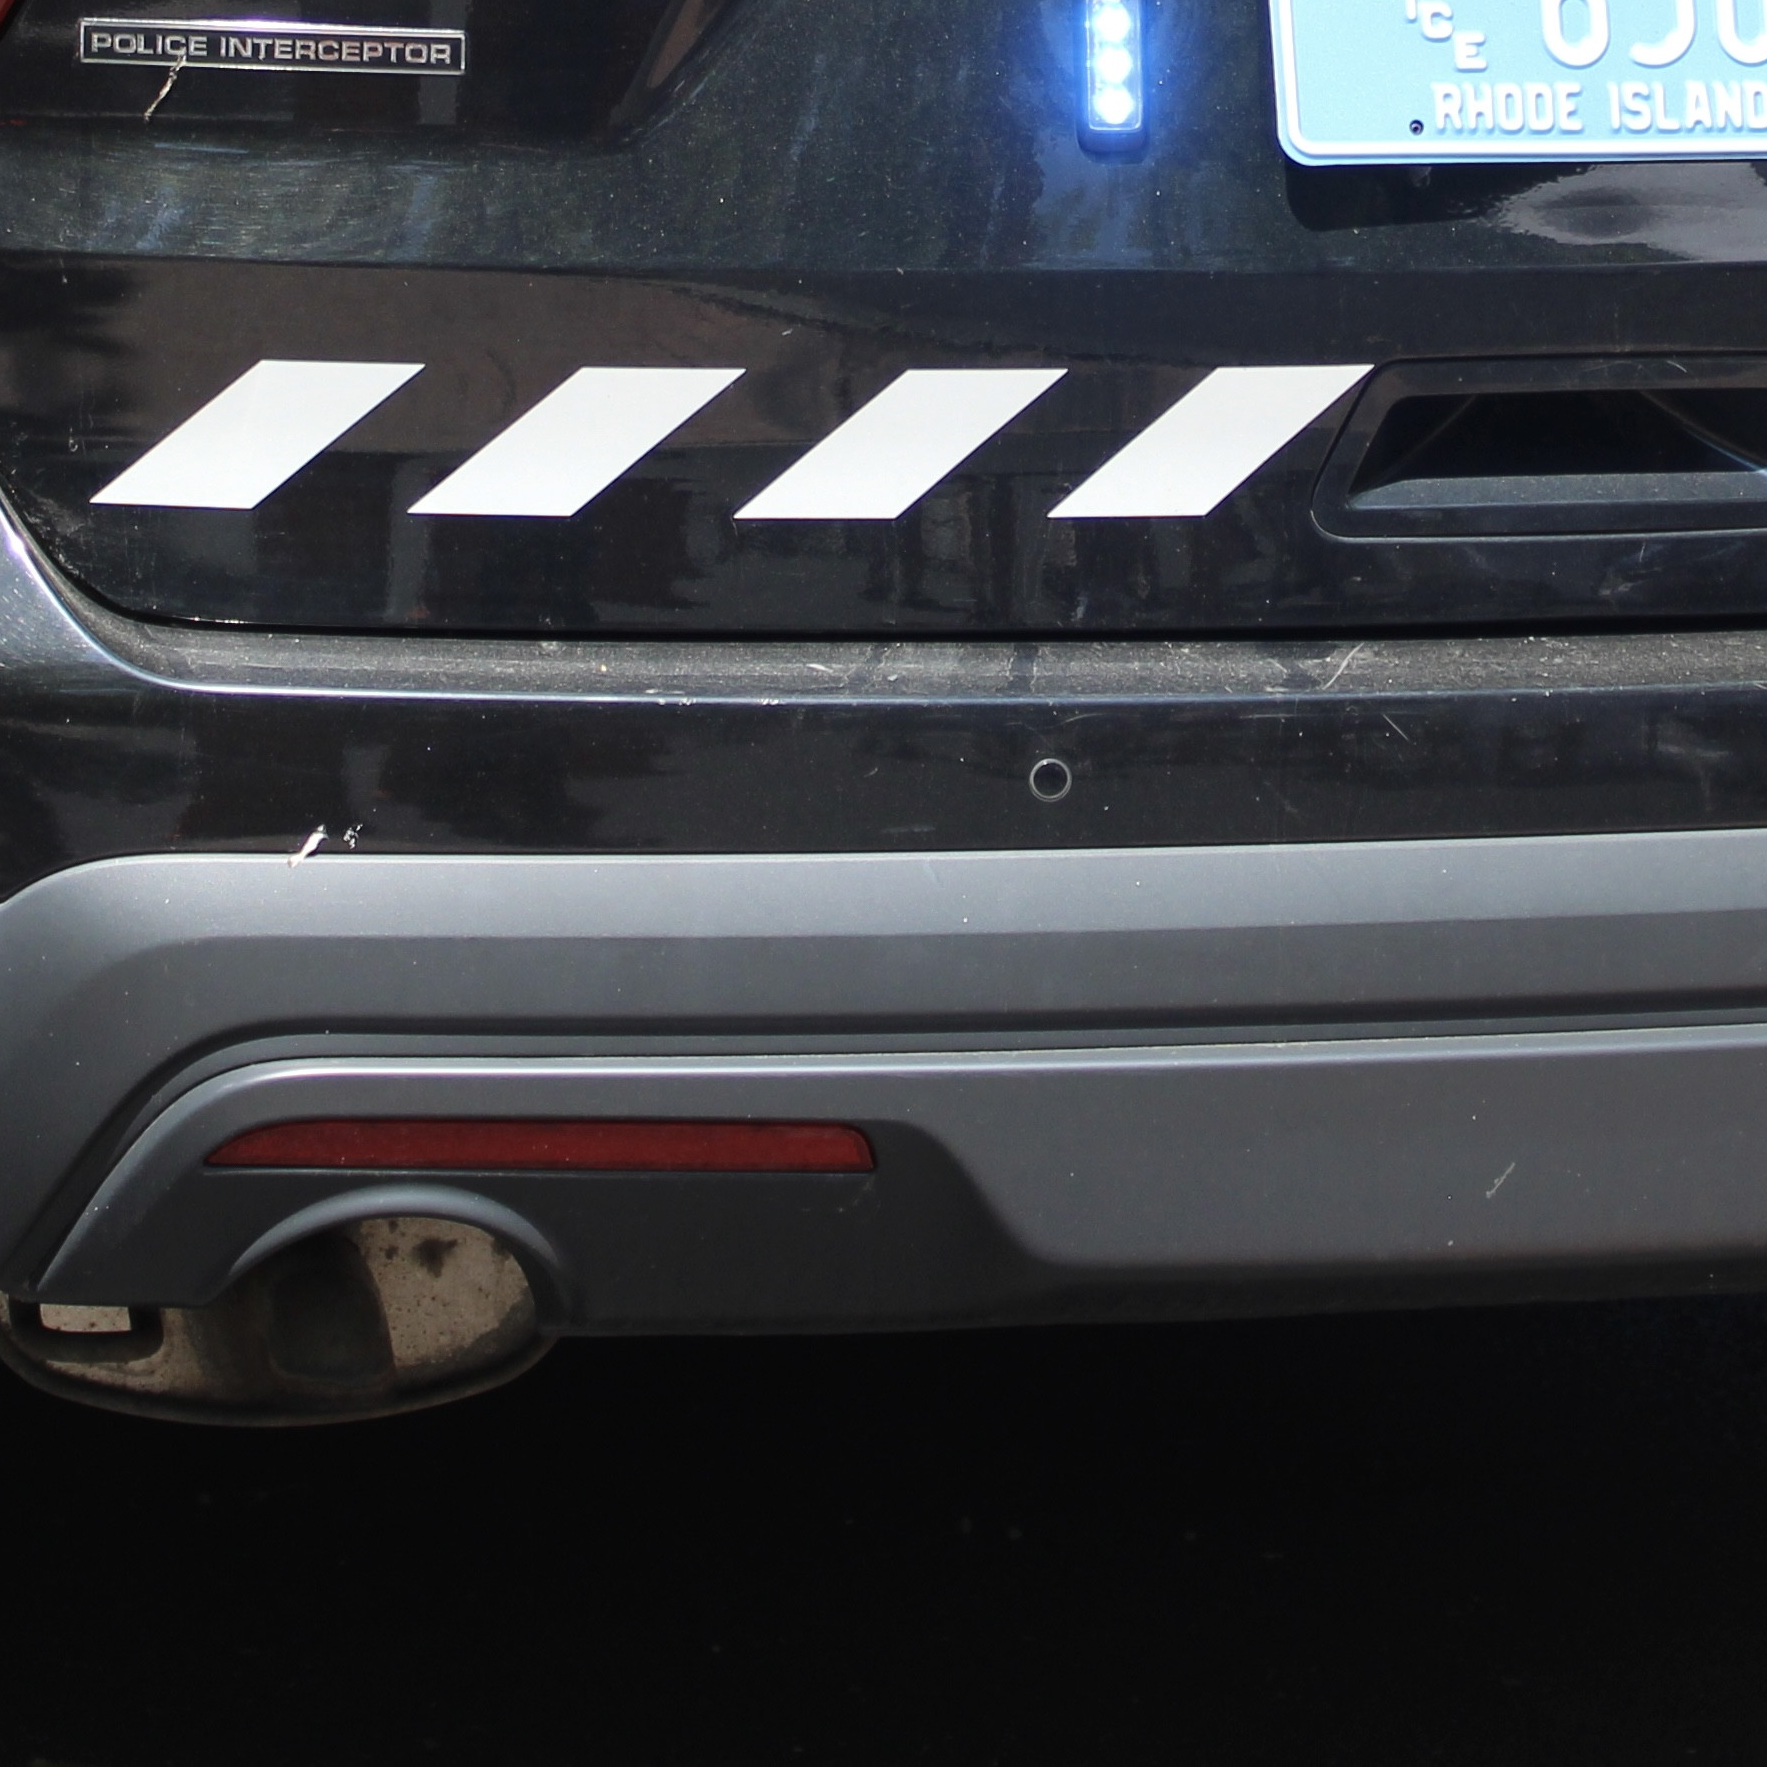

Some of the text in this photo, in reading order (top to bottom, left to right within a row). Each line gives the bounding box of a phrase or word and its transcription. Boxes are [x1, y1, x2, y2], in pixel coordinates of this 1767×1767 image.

[91, 32, 452, 65] POLICE INTERCEPTOR
[1433, 81, 1584, 133] RHODE
